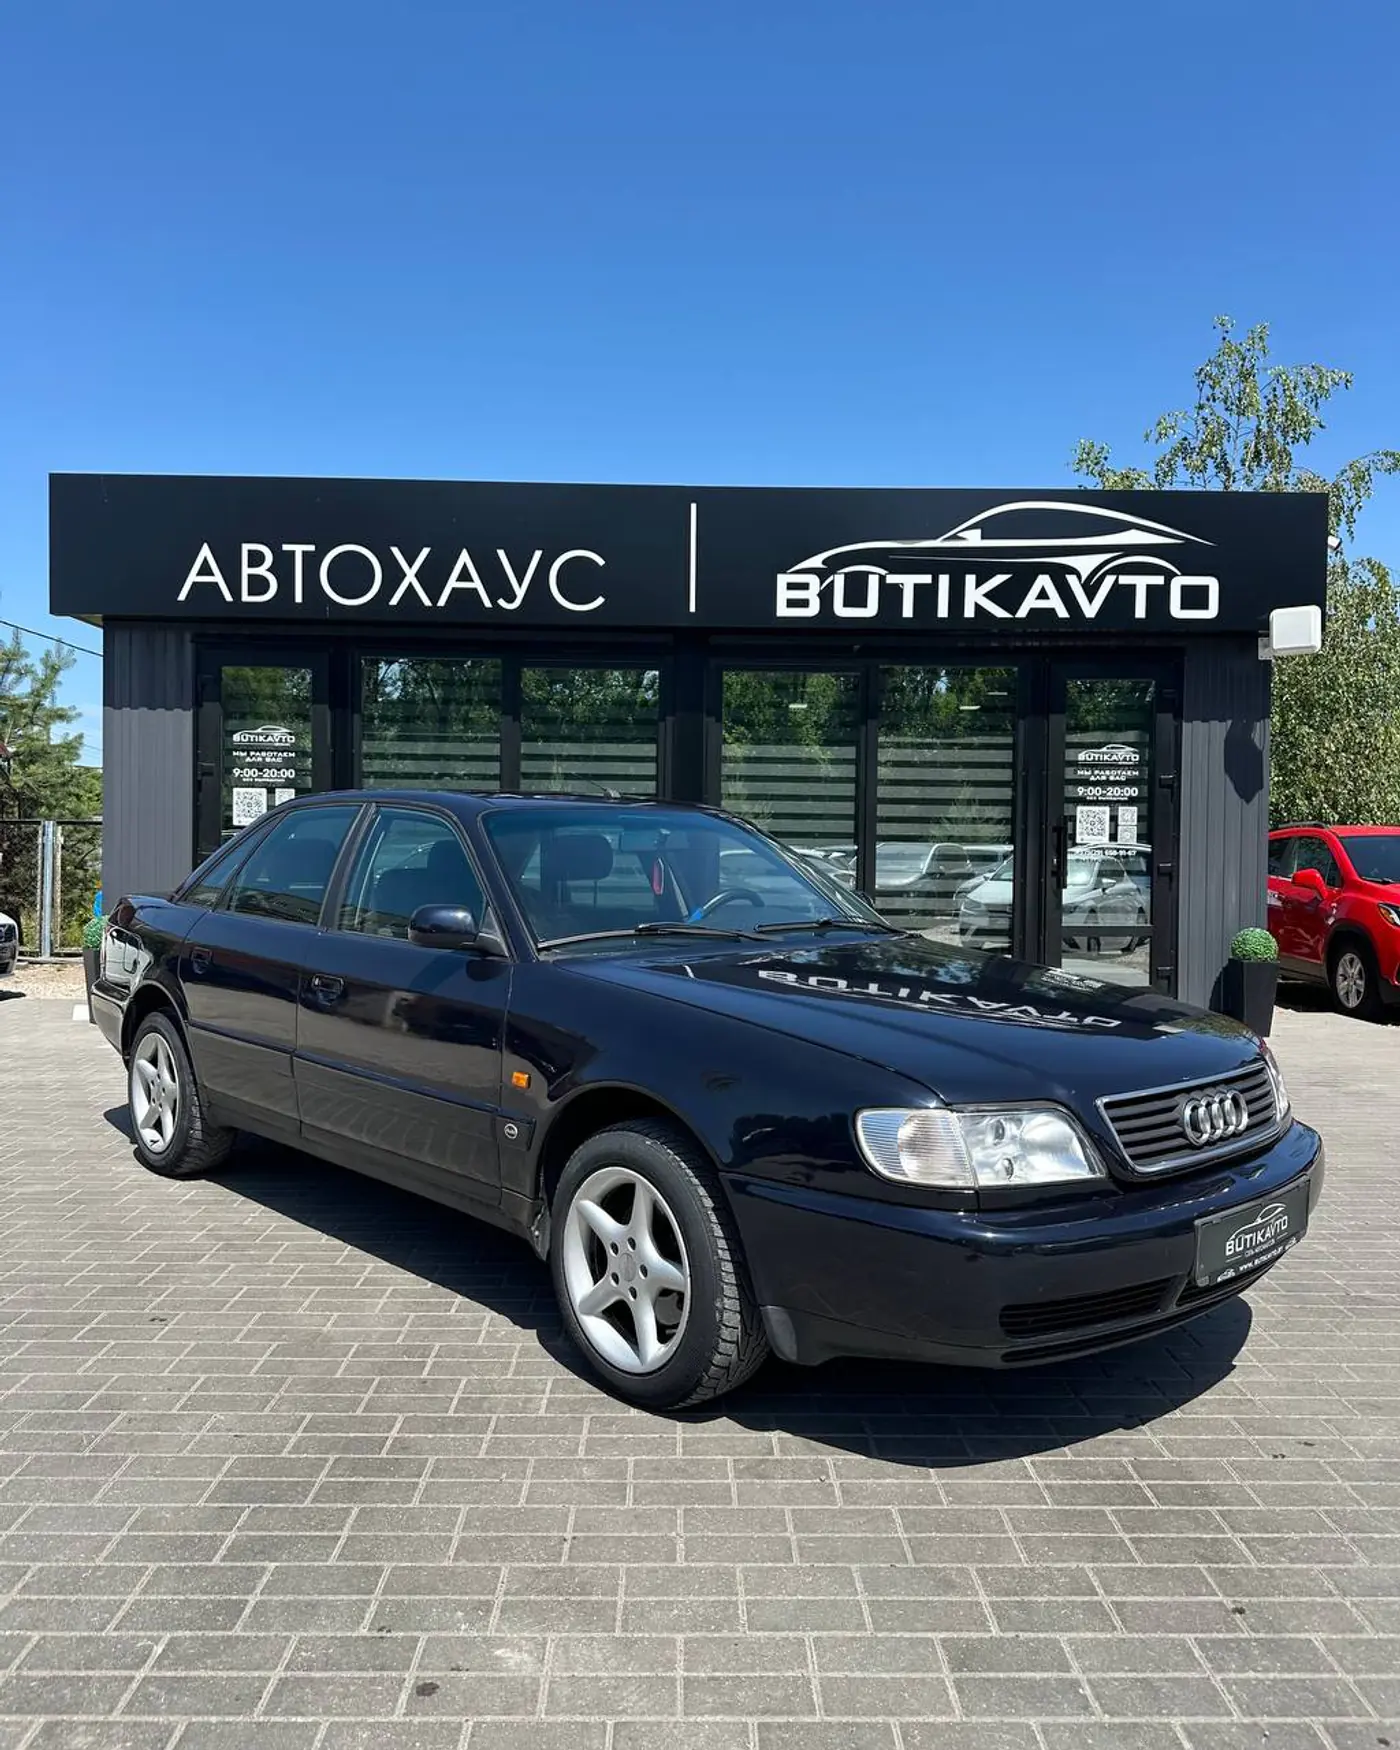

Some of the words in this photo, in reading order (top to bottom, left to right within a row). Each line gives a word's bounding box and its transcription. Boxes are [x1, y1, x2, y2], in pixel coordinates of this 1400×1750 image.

[177, 542, 606, 612] АВТОХАУС
[775, 572, 1220, 620] BUTIKAVTO
[233, 734, 296, 743] BUTIKAVTO
[1078, 753, 1140, 762] BUTIKAVTO
[233, 767, 296, 779] 9:00-20:00
[1077, 786, 1139, 797] 9:00-20:00
[1225, 1215, 1288, 1256] BUTIKAVTO
